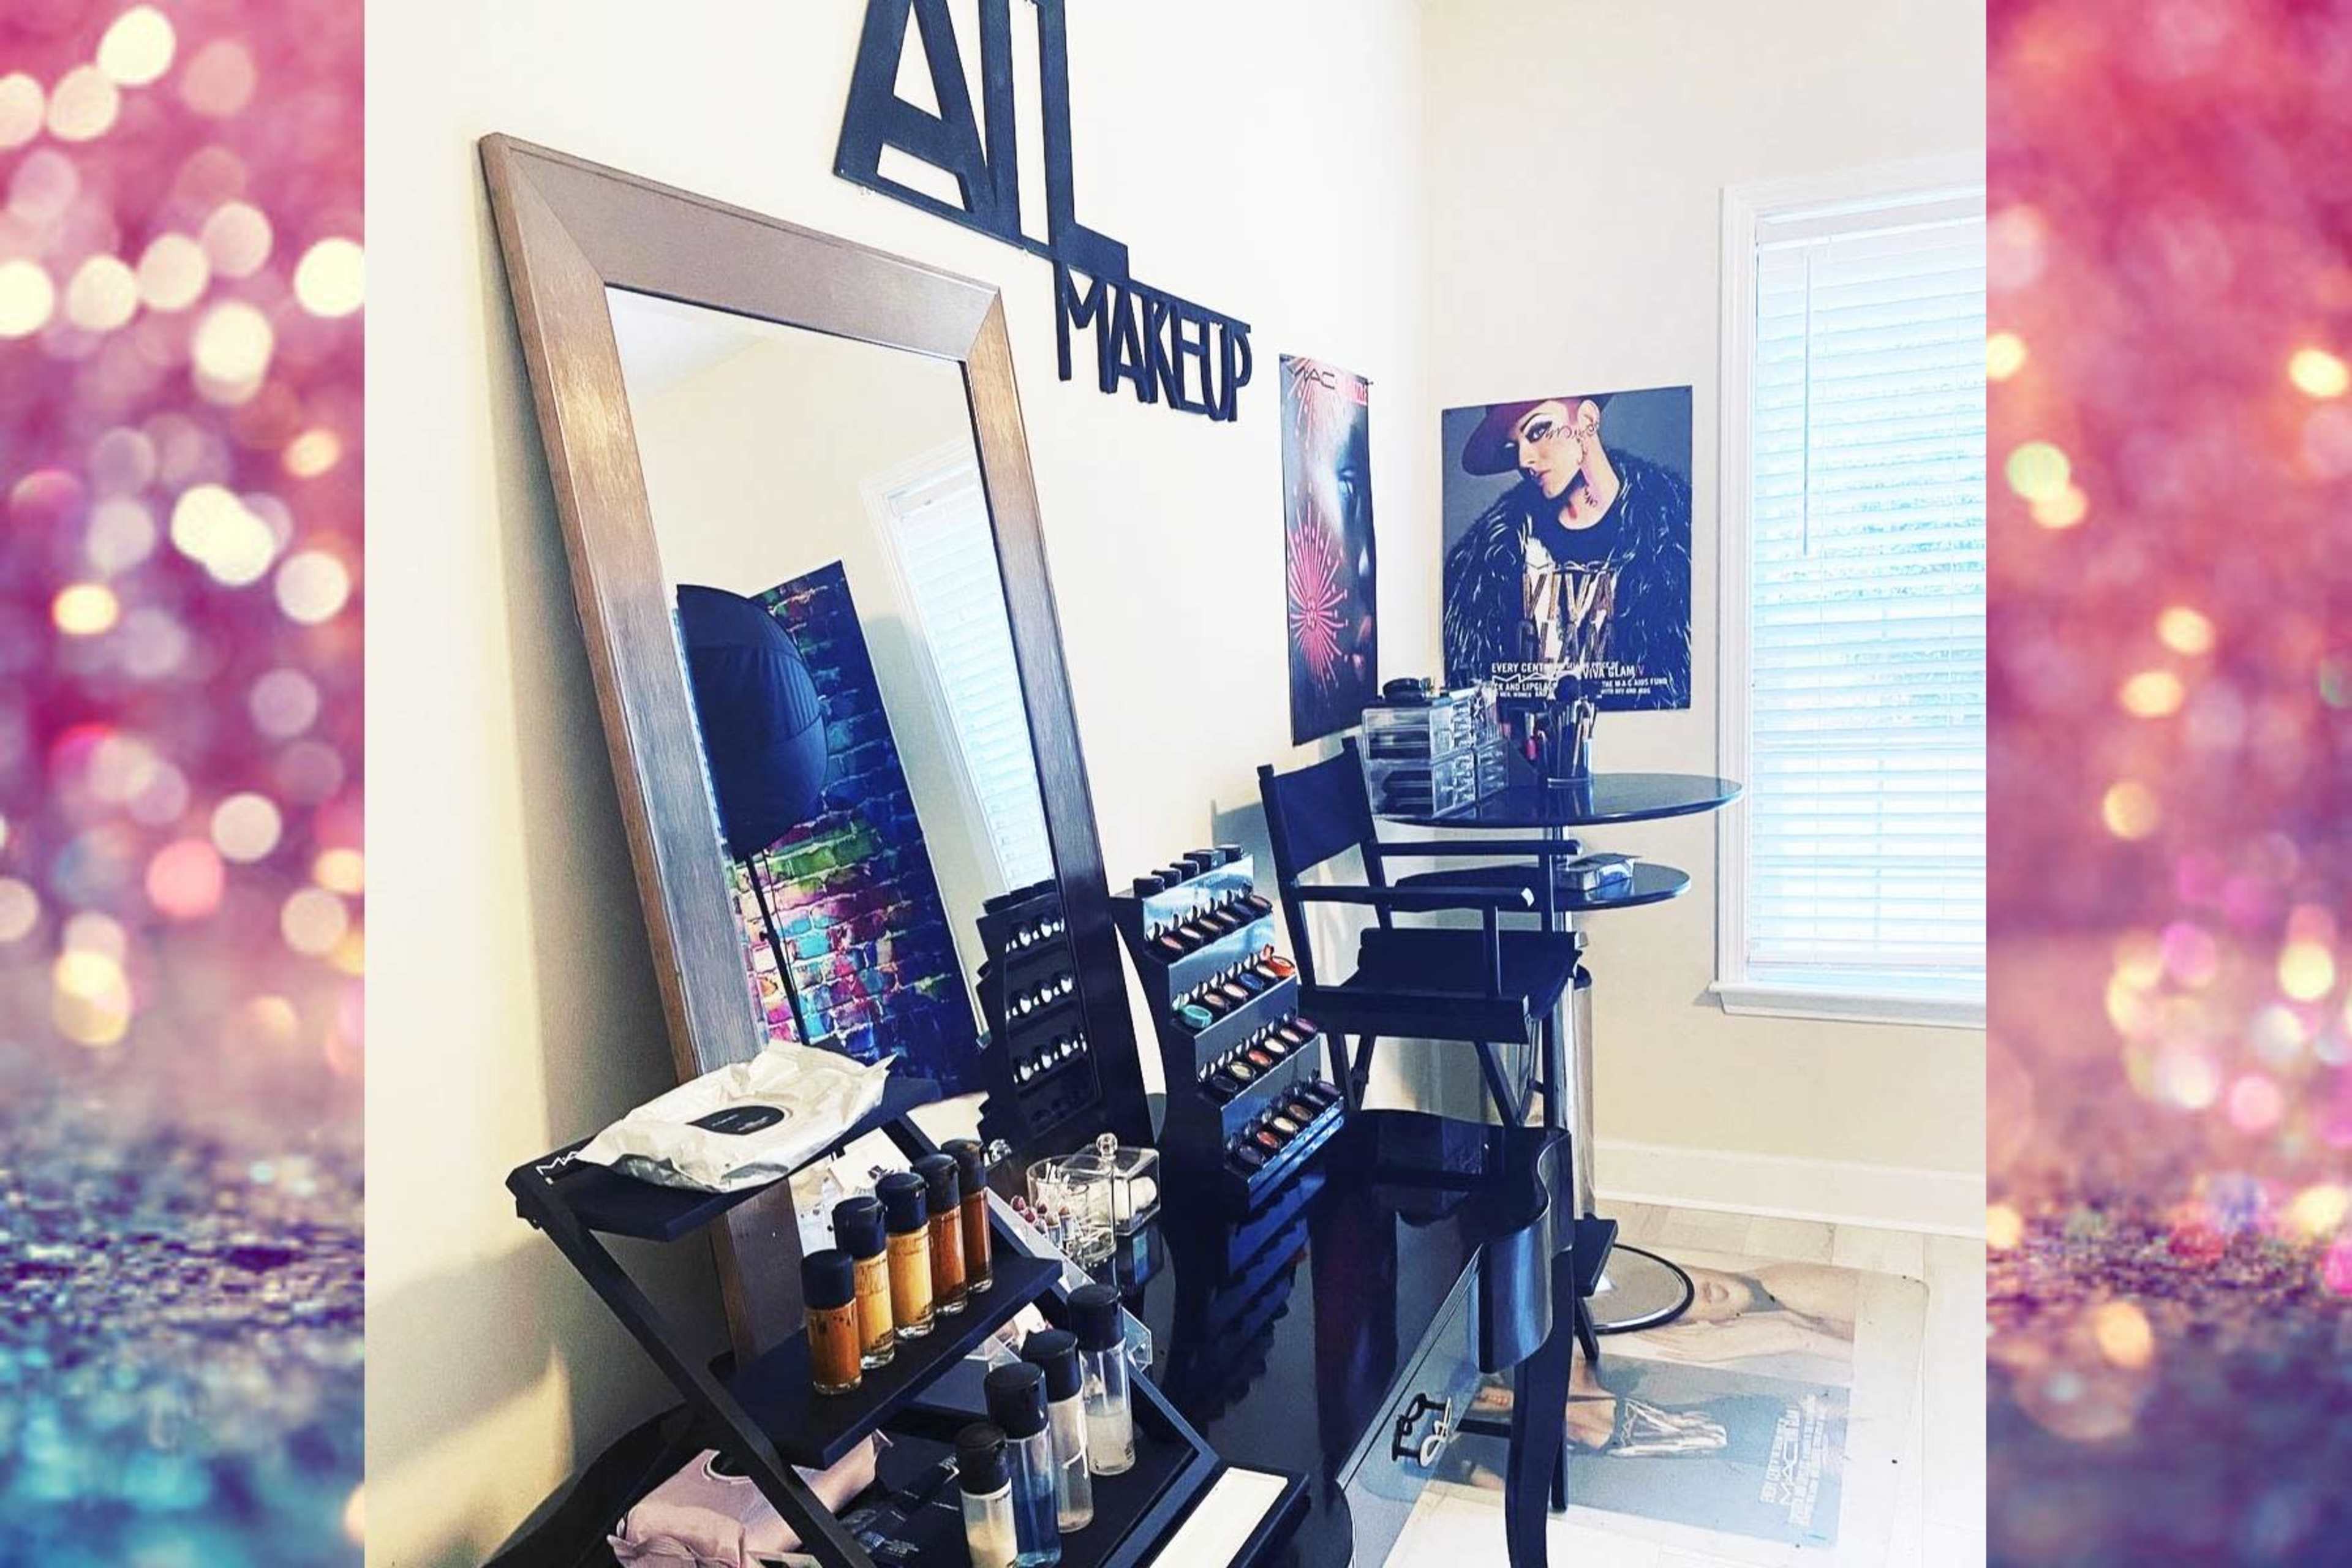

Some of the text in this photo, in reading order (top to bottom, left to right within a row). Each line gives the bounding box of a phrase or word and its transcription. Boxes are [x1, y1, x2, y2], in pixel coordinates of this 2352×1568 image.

[1052, 262, 1252, 423] MAKEUP
[1523, 570, 1618, 620] VIVA
[1491, 662, 1519, 673] EVERY
[1520, 662, 1544, 673] CENT
[1583, 666, 1605, 679] VIVA
[1607, 665, 1635, 678] GLAM
[1505, 681, 1521, 691] AND
